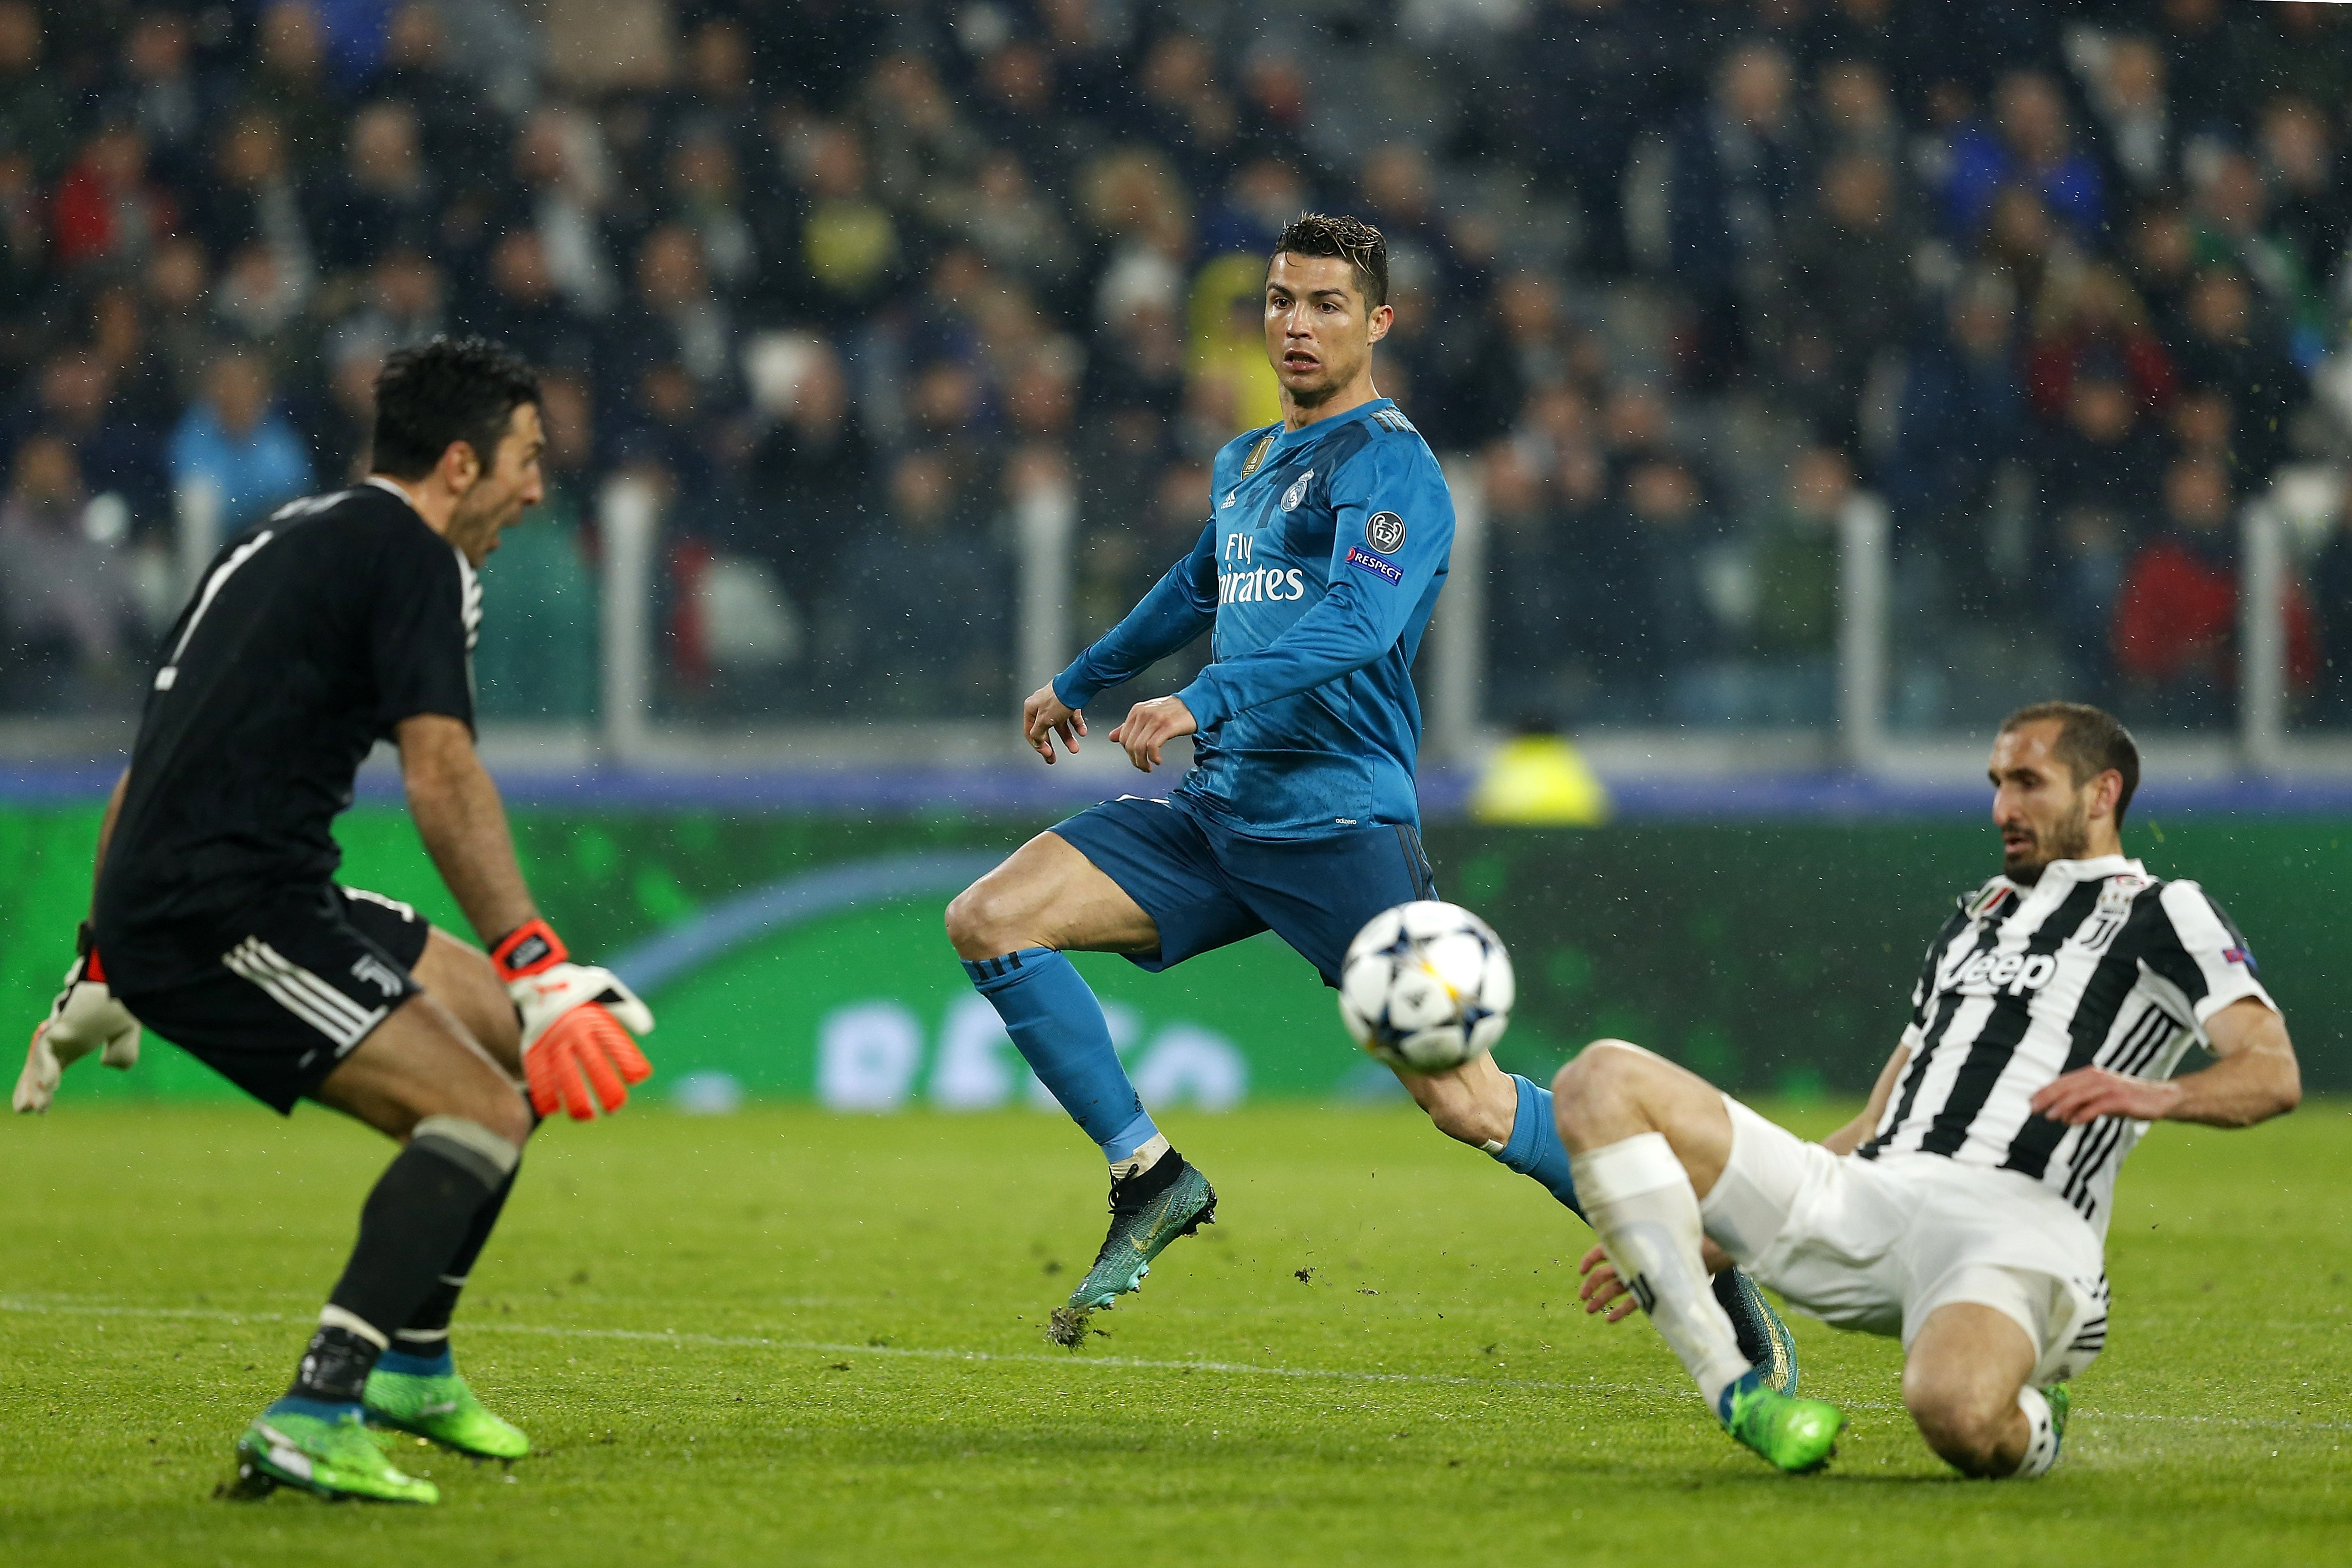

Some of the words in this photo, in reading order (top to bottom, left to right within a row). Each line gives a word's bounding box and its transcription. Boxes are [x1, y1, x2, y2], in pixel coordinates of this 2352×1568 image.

[1225, 533, 1253, 565] Fly
[1376, 528, 1393, 544] 12
[1355, 553, 1402, 580] RESPECT
[1940, 948, 2057, 997] Jeep
